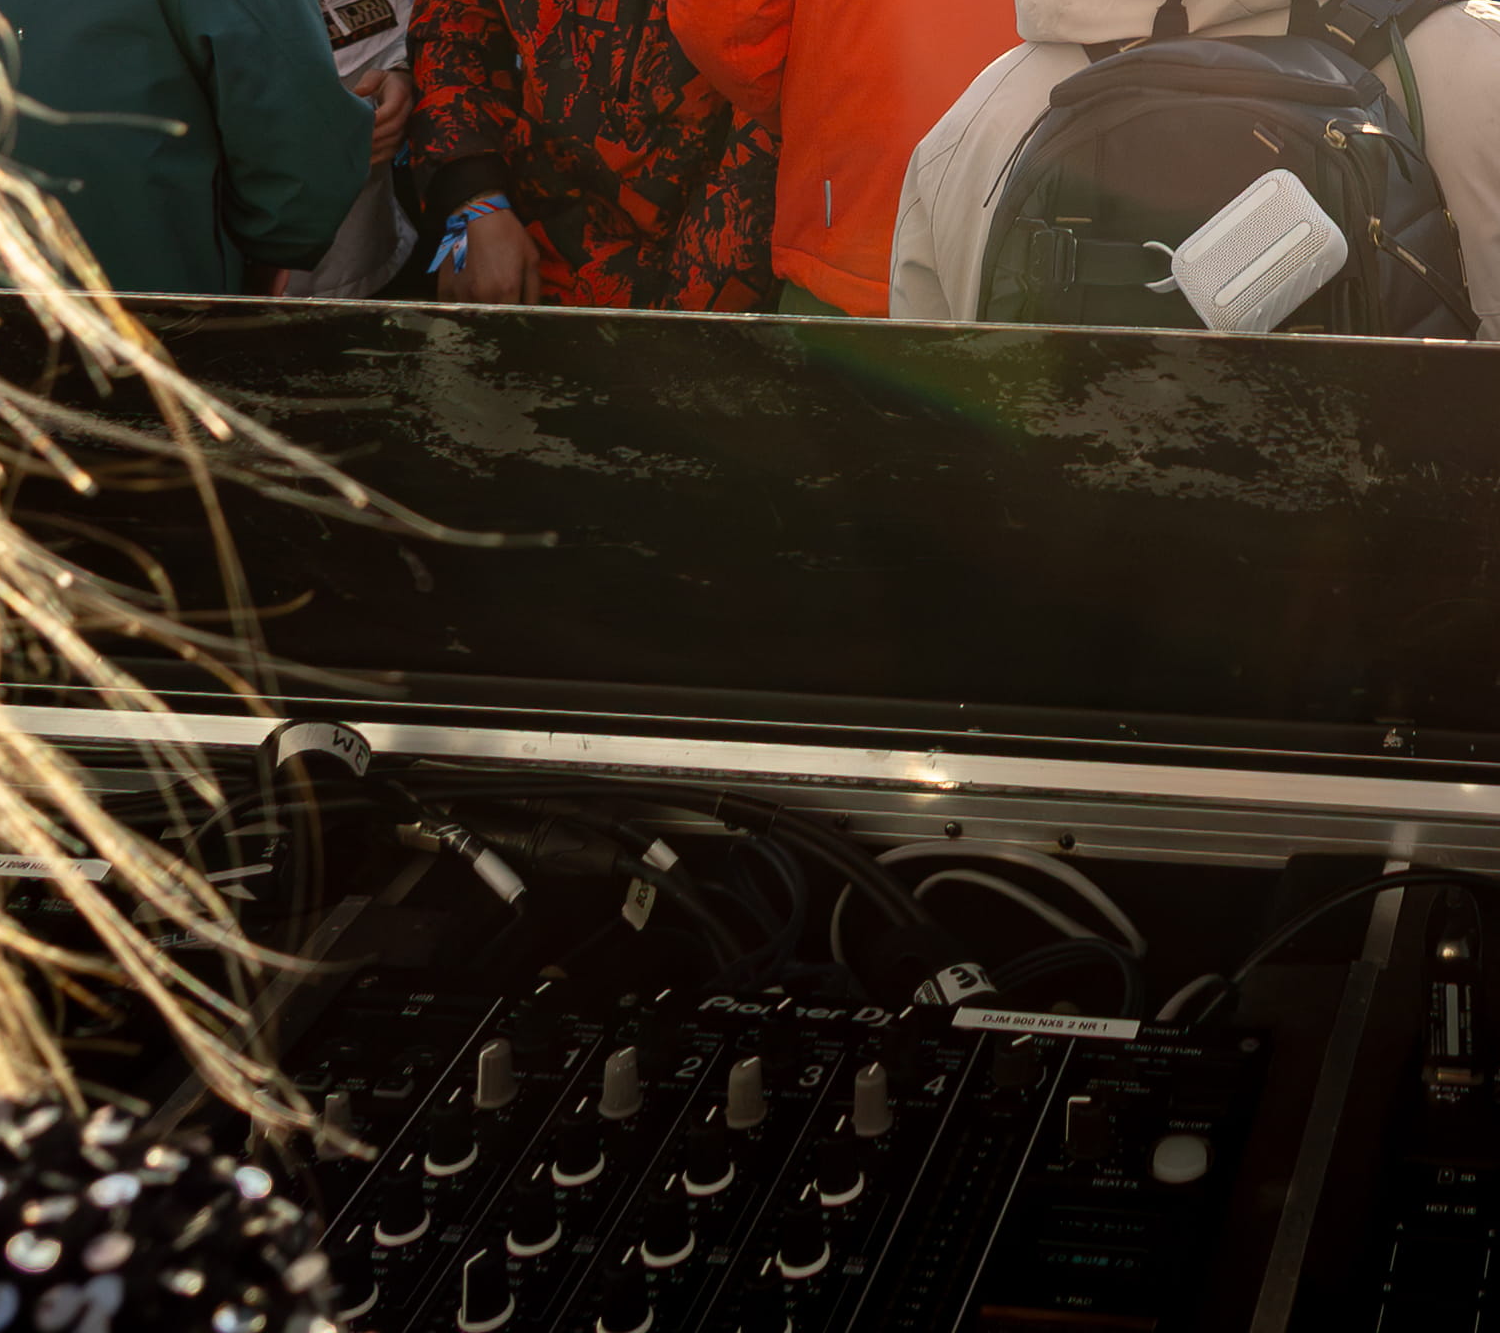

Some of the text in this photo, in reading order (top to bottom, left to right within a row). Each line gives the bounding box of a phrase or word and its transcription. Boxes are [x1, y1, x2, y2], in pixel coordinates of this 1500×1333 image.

[698, 995, 848, 1022] Pioer
[982, 1014, 1010, 1025] DJM
[1037, 1018, 1065, 1030] NXS
[1067, 1020, 1077, 1030] 2
[1078, 1021, 1098, 1031] NR
[674, 1055, 704, 1079] 2
[798, 1065, 825, 1088] 3
[922, 1074, 949, 1096] 4
